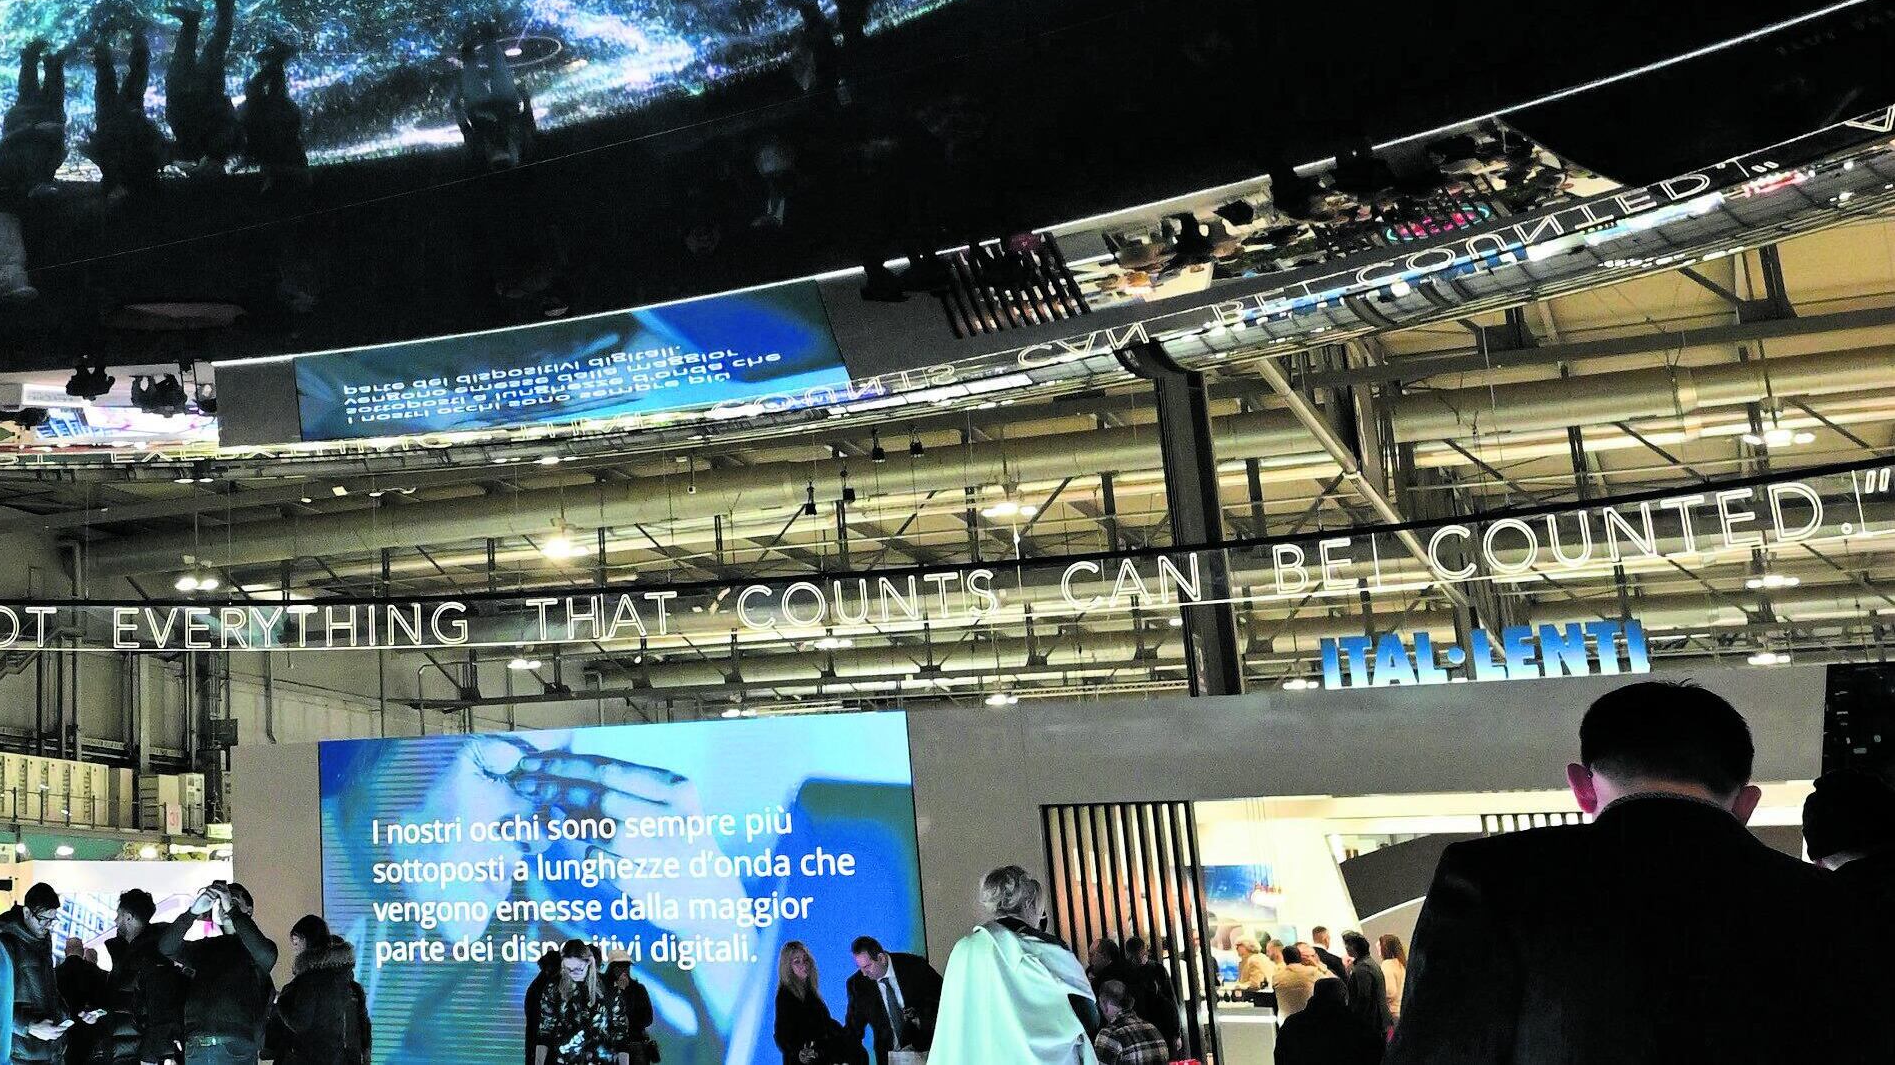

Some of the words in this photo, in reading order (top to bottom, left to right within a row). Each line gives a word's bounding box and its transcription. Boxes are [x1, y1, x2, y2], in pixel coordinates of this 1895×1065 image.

[114, 600, 470, 650] EVERYTHING
[525, 589, 678, 642] THAT
[736, 568, 1001, 630] COUNTS
[1060, 552, 1203, 611] CAN
[1272, 537, 1359, 595] BE
[372, 820, 379, 845] I
[387, 816, 462, 844] nostri
[470, 813, 539, 842] occhi
[547, 816, 617, 840] sono
[625, 812, 736, 847] sempre
[746, 805, 793, 843] più
[372, 855, 506, 893] sottoposti
[513, 861, 529, 882] a
[537, 851, 680, 888] lunghezze
[688, 848, 791, 879] d'onda
[800, 846, 856, 877] che
[372, 900, 489, 930] vengono
[495, 897, 602, 922] emesse
[610, 892, 679, 921] dalla
[688, 892, 814, 928] maggior
[375, 937, 445, 968] parte
[453, 936, 495, 962] dei
[650, 937, 758, 970] digitali.
